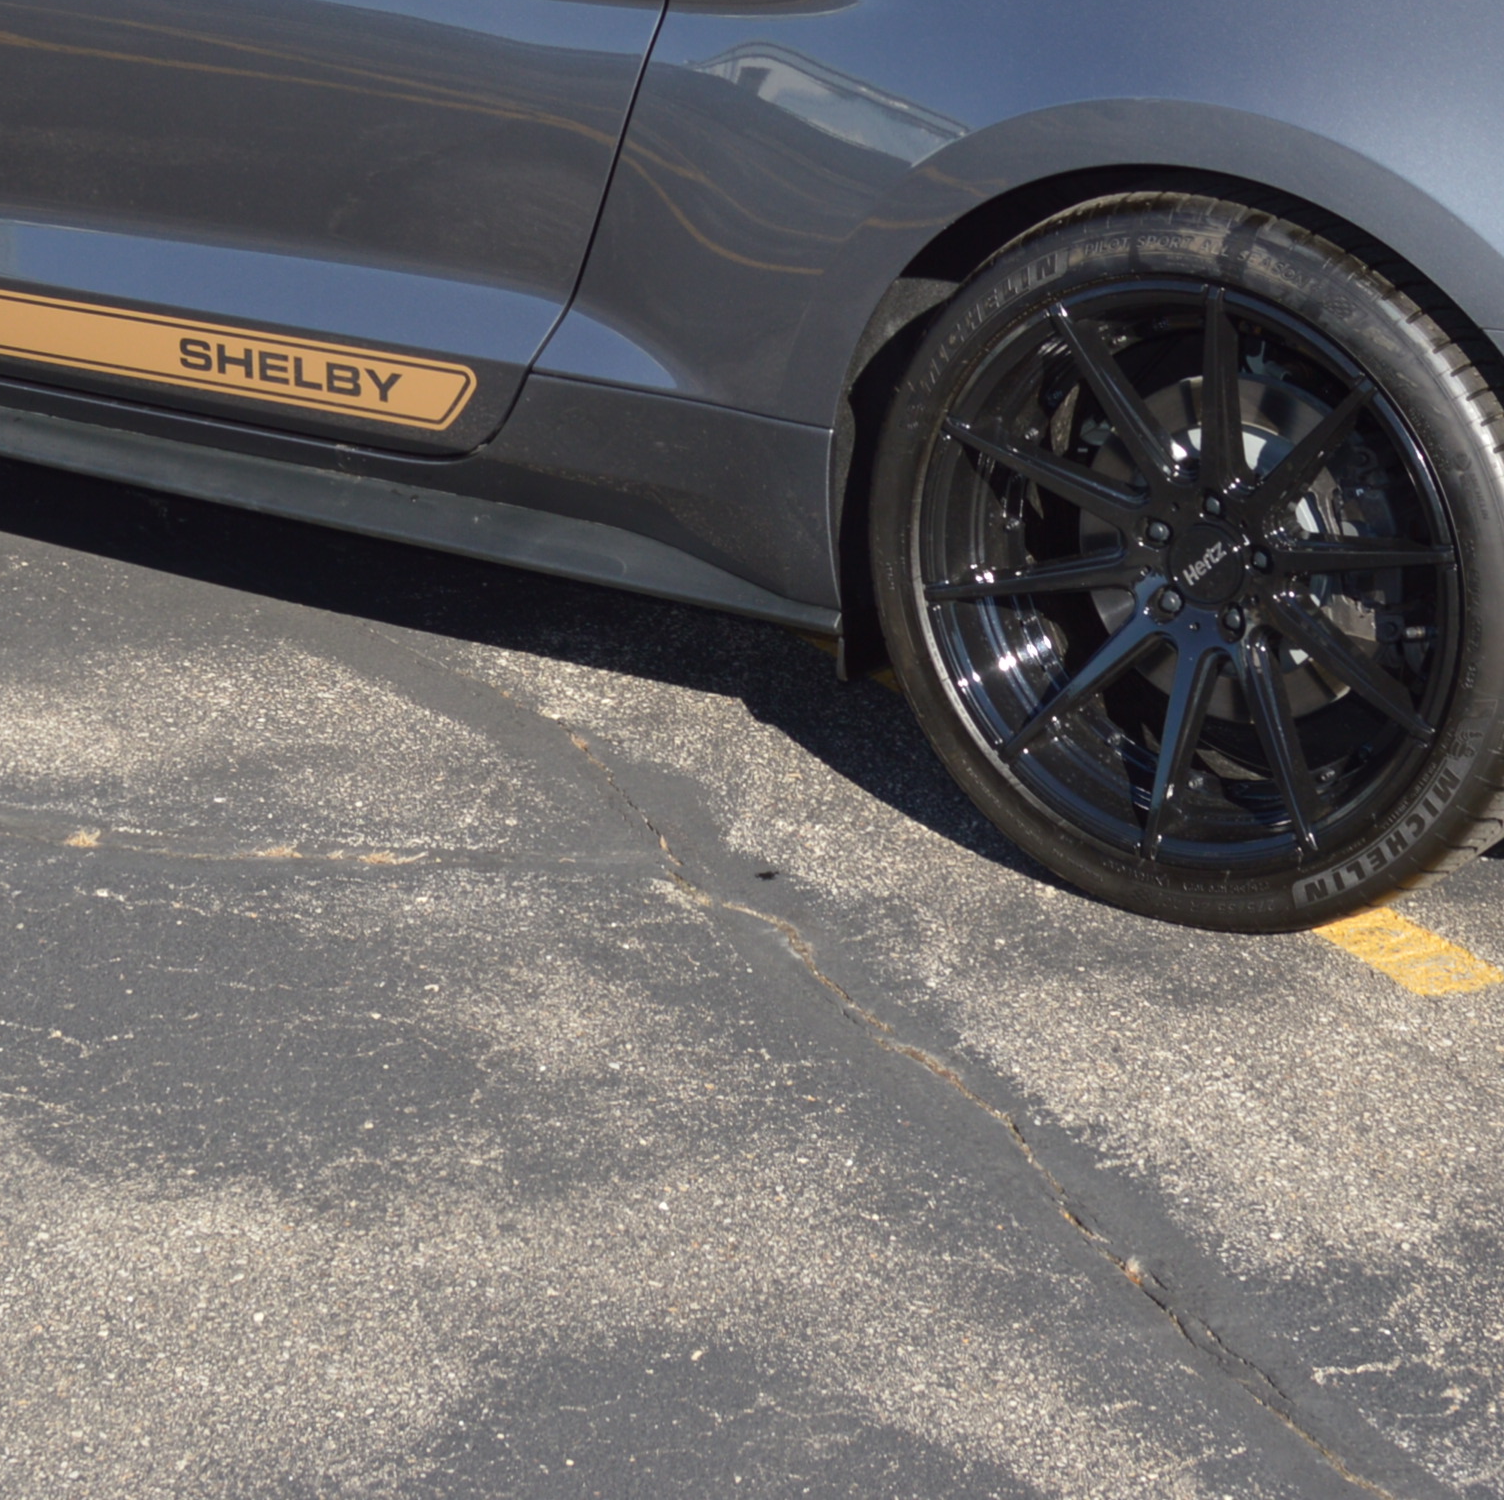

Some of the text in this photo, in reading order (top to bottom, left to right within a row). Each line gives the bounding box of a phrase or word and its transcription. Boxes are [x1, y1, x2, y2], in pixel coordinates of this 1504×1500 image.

[179, 337, 402, 403] SHELBY
[1182, 541, 1227, 586] Hertz
[1303, 766, 1463, 902] MICHELIN
